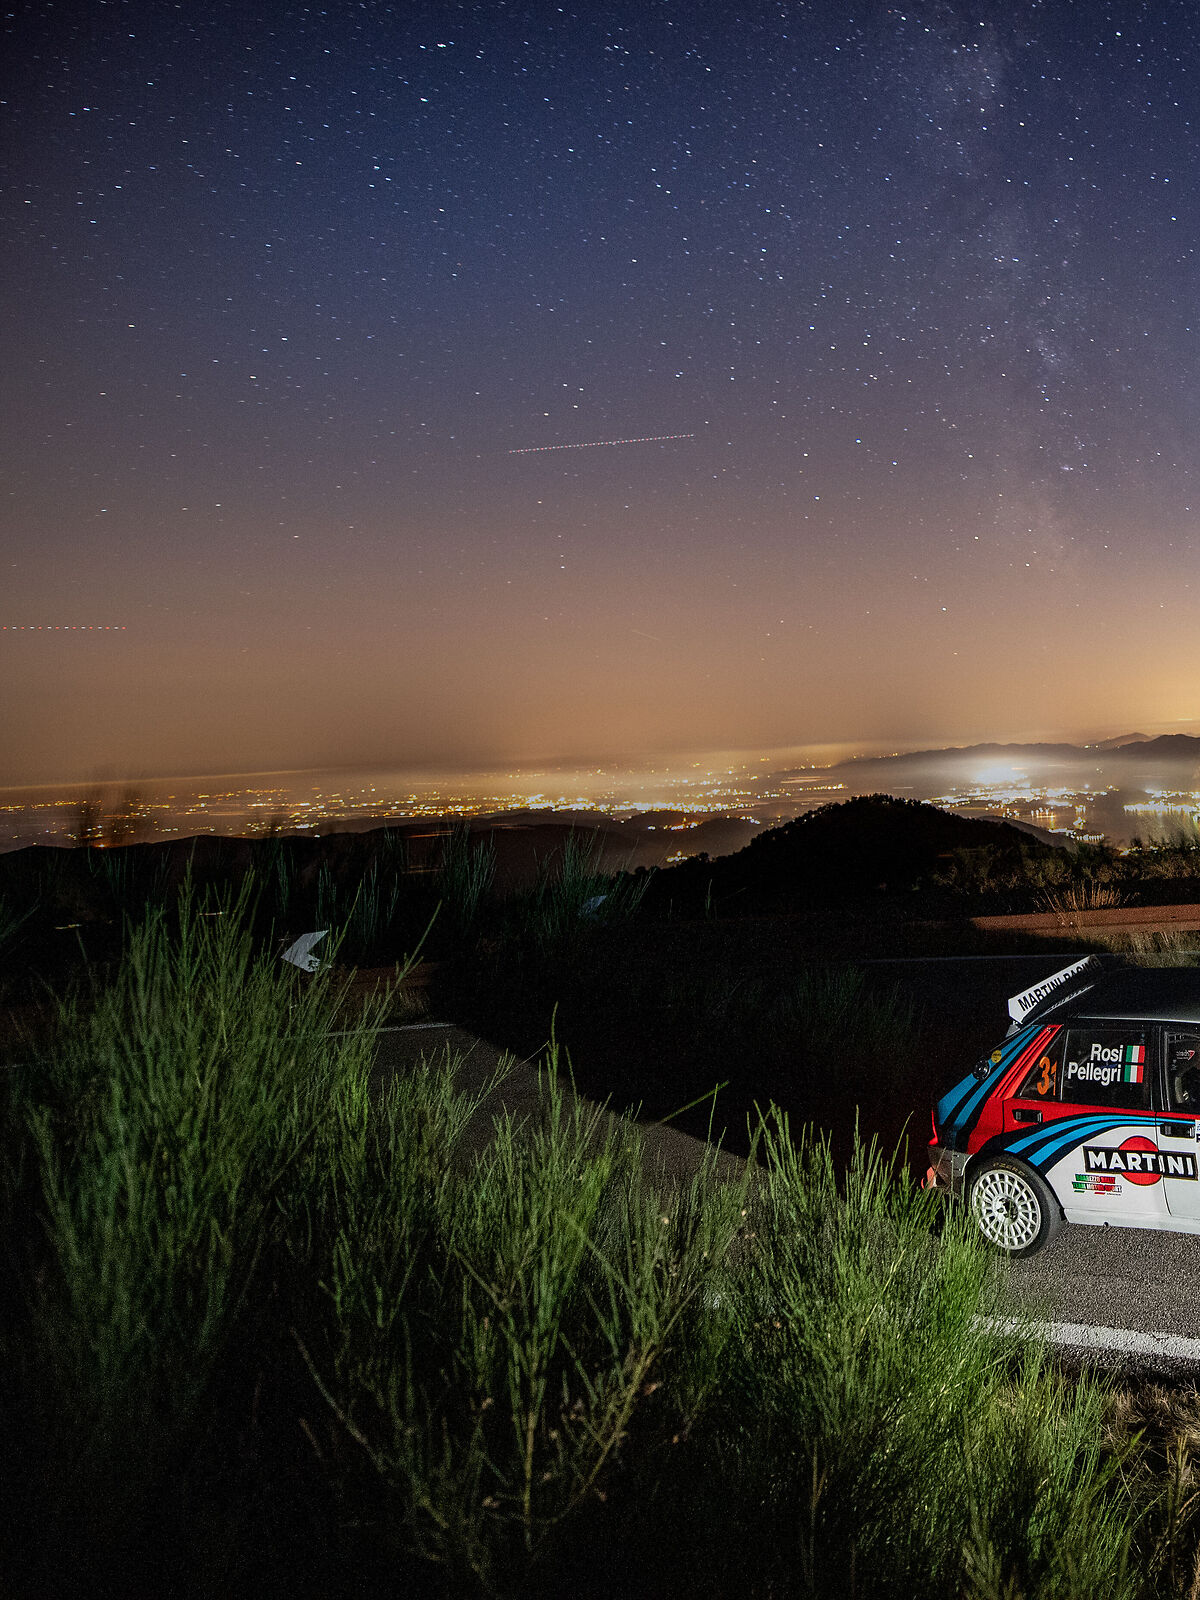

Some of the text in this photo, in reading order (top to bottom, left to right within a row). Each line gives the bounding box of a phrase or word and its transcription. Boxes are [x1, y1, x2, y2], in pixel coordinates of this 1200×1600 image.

[1017, 977, 1062, 1011] MARTINI
[1090, 1043, 1124, 1062] Rosi
[1036, 1056, 1057, 1096] 31
[1067, 1061, 1122, 1086] Pellegri
[1088, 1150, 1194, 1176] MARTINI
